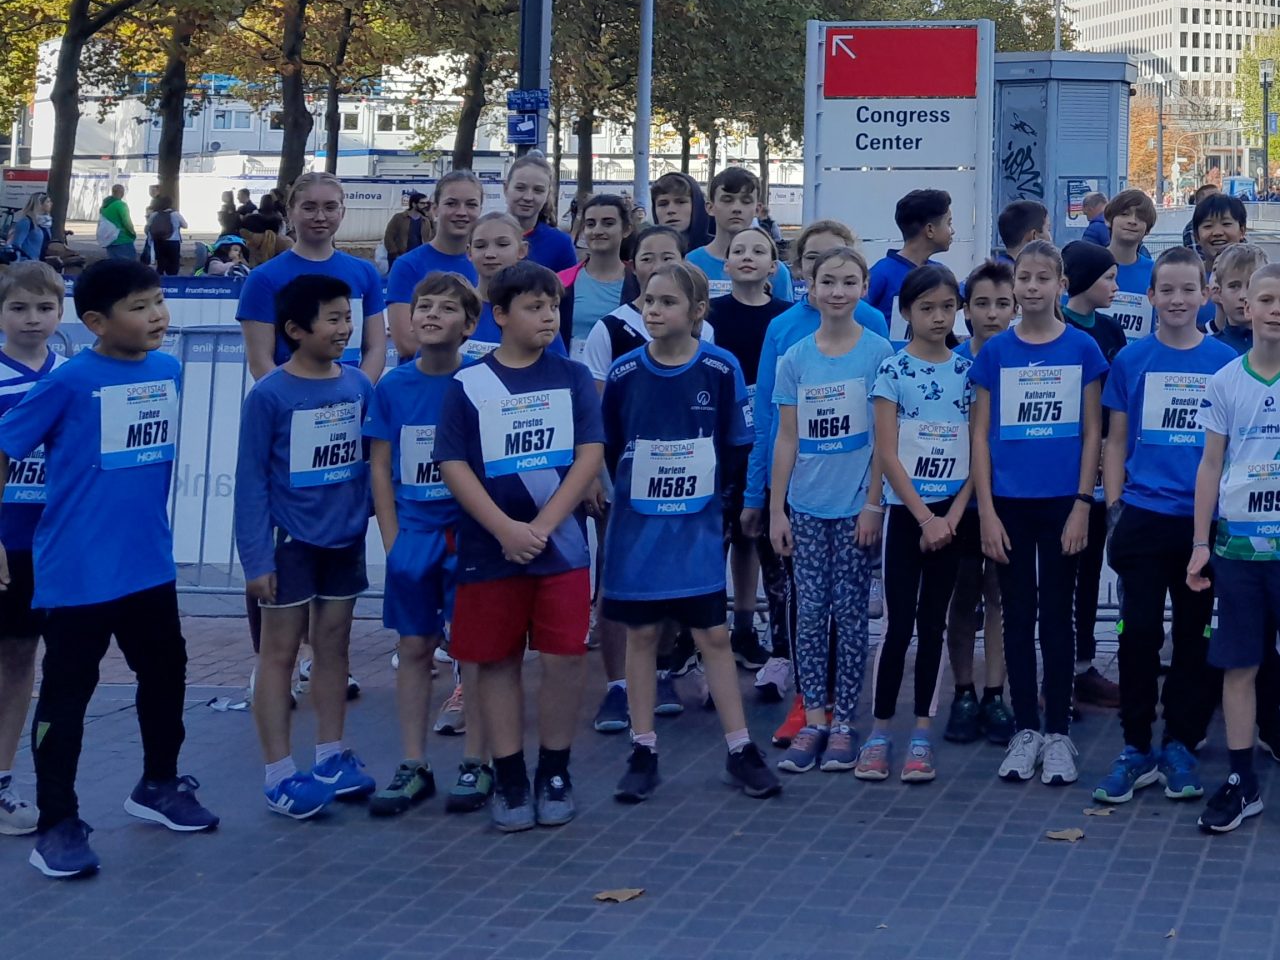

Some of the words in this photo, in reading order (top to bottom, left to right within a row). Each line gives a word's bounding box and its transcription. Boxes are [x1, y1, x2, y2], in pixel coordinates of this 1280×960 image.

[856, 105, 951, 128] Congress
[855, 132, 923, 151] Center
[1112, 313, 1143, 331] M979
[1018, 369, 1063, 377] SPORTSTADT
[1164, 375, 1207, 385] SPORTSTADT
[1024, 390, 1056, 399] Katharina
[500, 393, 550, 408] SPORTSTADT
[1171, 396, 1198, 406] Benedikt
[816, 407, 835, 417] Marie
[1017, 401, 1063, 422] M575
[512, 418, 543, 430] Christos
[1161, 408, 1202, 429] M63
[808, 415, 850, 438] M664
[918, 424, 960, 434] SPORTSTADT
[1025, 427, 1054, 436] HOKA
[126, 420, 168, 448] M678
[330, 432, 347, 442] Liang
[1169, 434, 1196, 443] HOKA
[505, 427, 555, 456] M637
[650, 442, 695, 452] SPORTSTADT
[817, 441, 843, 451] HOKA
[136, 450, 163, 463] HOKA
[312, 440, 357, 468] M632
[931, 446, 945, 456] Lina
[516, 455, 548, 468] HOKA
[658, 465, 686, 475] Marlene
[914, 457, 956, 479] M577
[323, 469, 351, 481] HOKA
[647, 475, 697, 498] M583
[919, 483, 947, 492] HOKA
[15, 490, 47, 501] HOKA
[657, 502, 687, 512] HOKA
